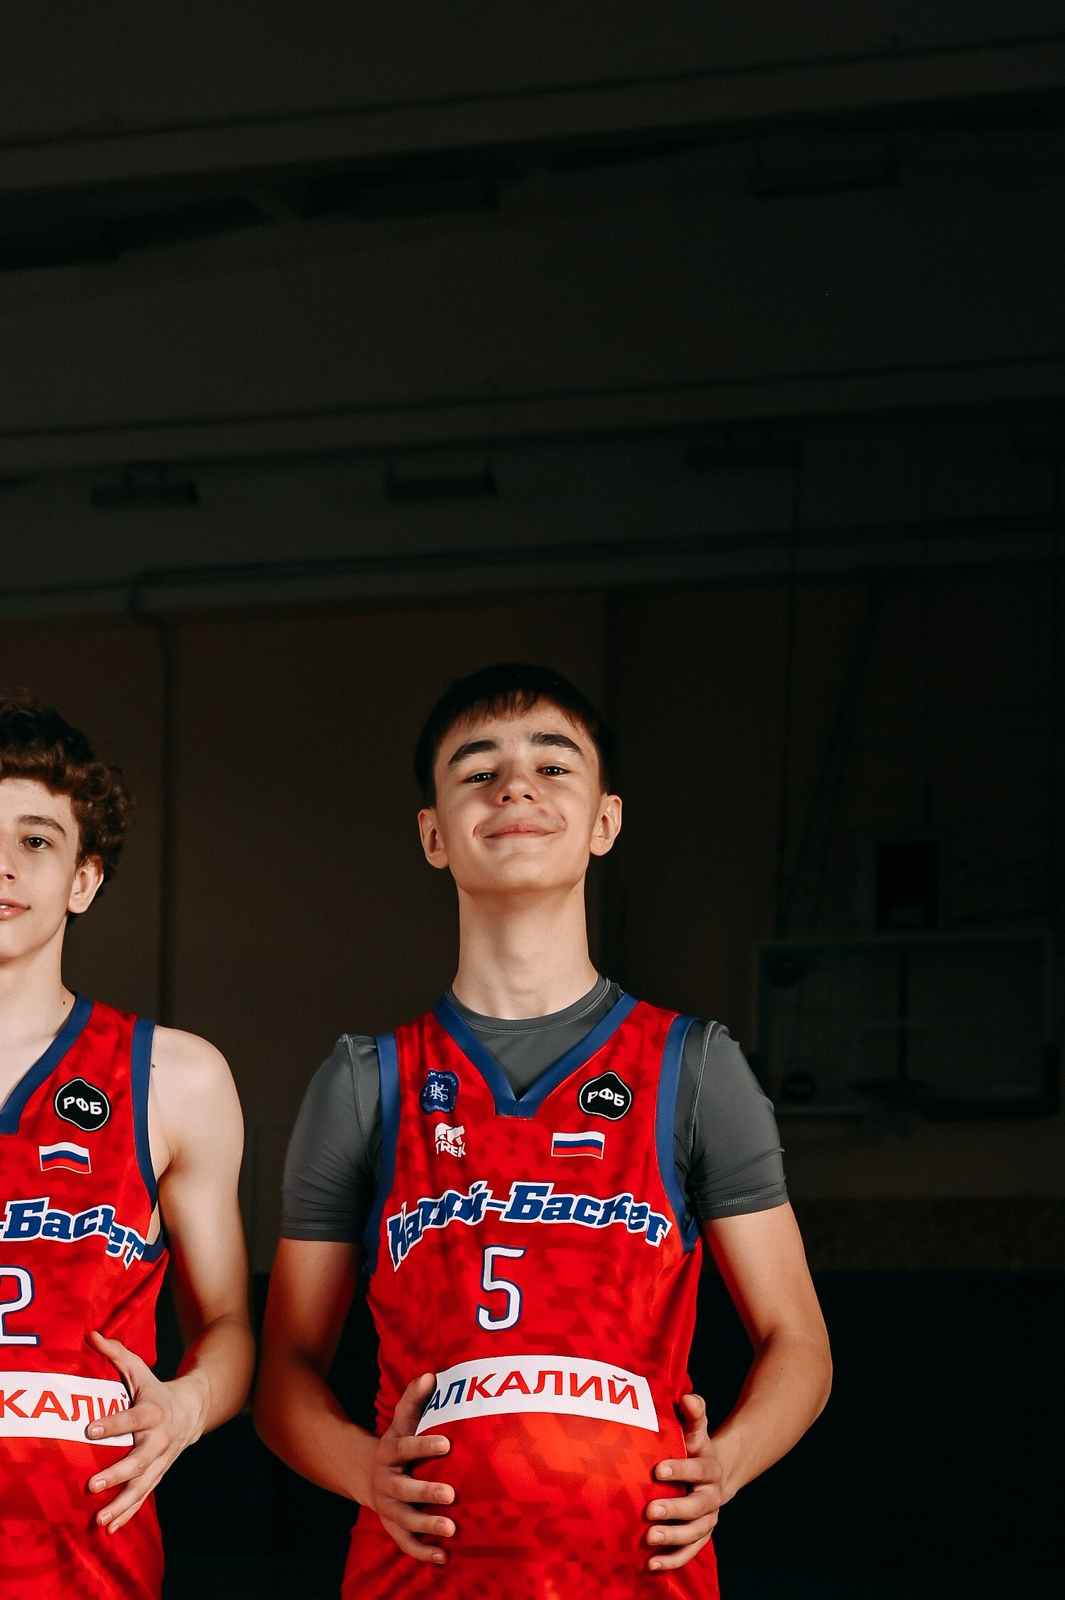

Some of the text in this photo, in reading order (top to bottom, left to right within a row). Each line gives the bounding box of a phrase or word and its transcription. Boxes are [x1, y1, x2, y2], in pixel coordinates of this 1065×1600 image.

[63, 1096, 103, 1116] РФБ
[587, 1087, 625, 1107] РФБ
[435, 1140, 467, 1158] TREK
[475, 1243, 528, 1333] 5
